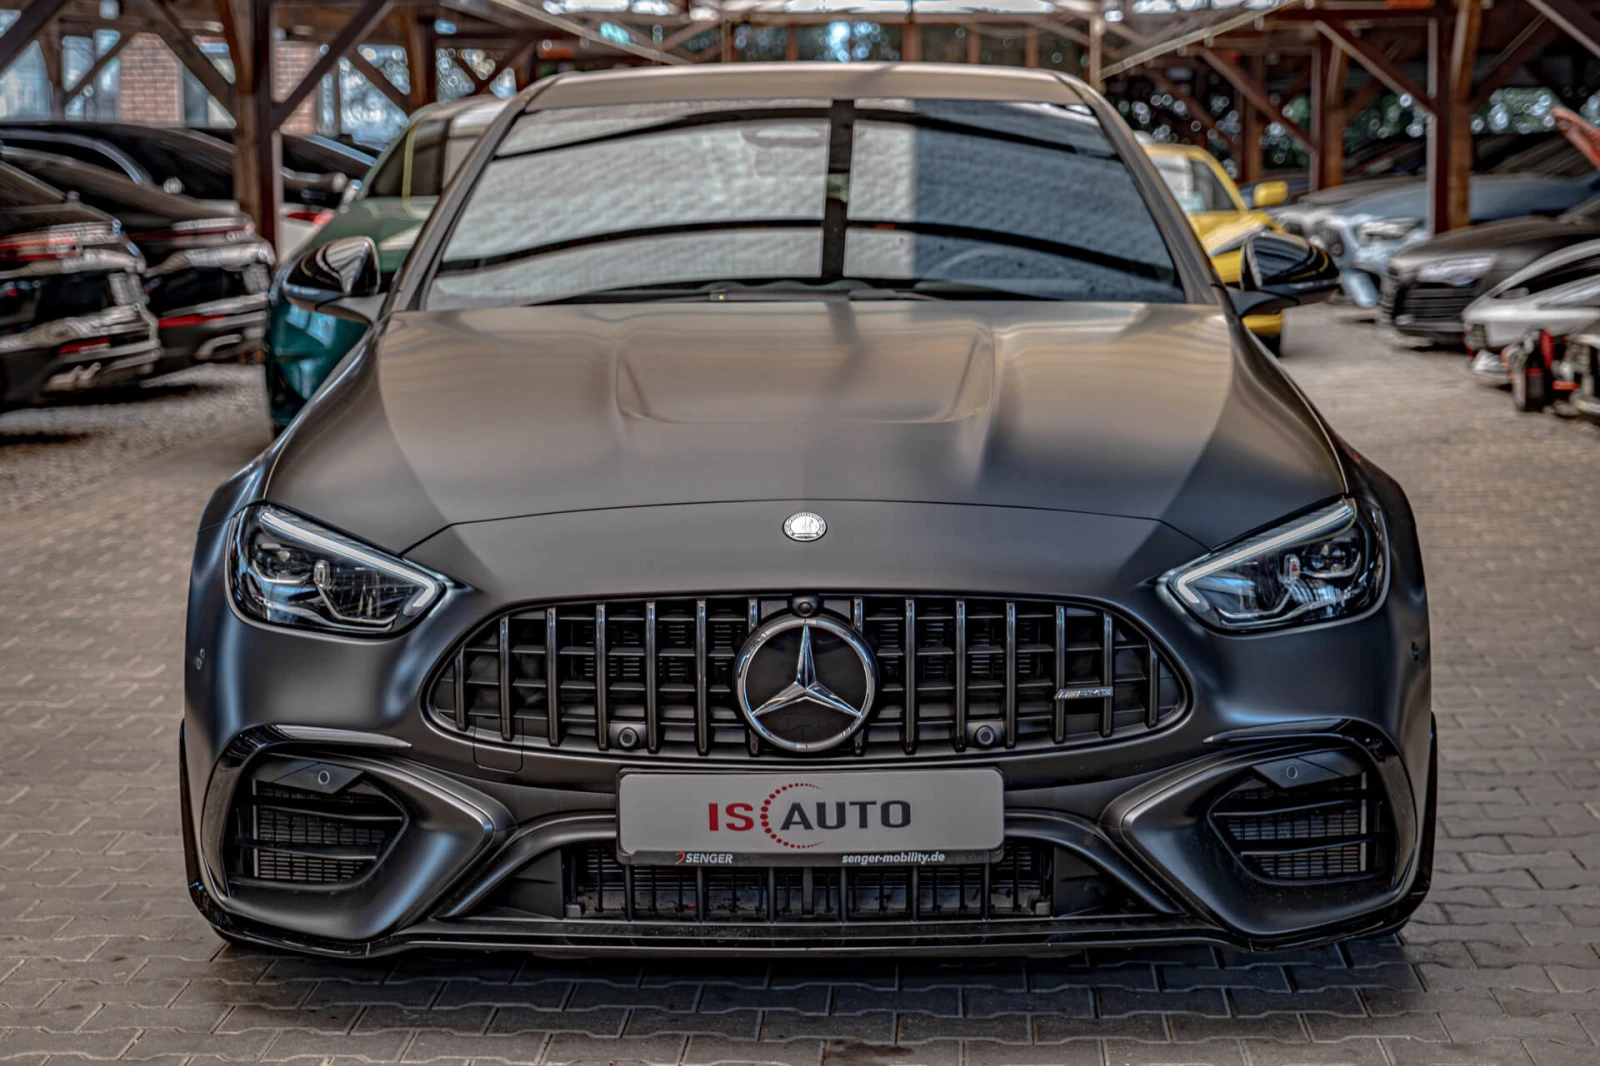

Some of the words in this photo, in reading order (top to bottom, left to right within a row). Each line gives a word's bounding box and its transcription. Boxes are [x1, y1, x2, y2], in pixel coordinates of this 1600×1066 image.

[708, 802, 754, 831] IS
[779, 801, 911, 830] AUTO
[686, 852, 733, 864] SENGER
[842, 852, 946, 865] senger-mobility.de
